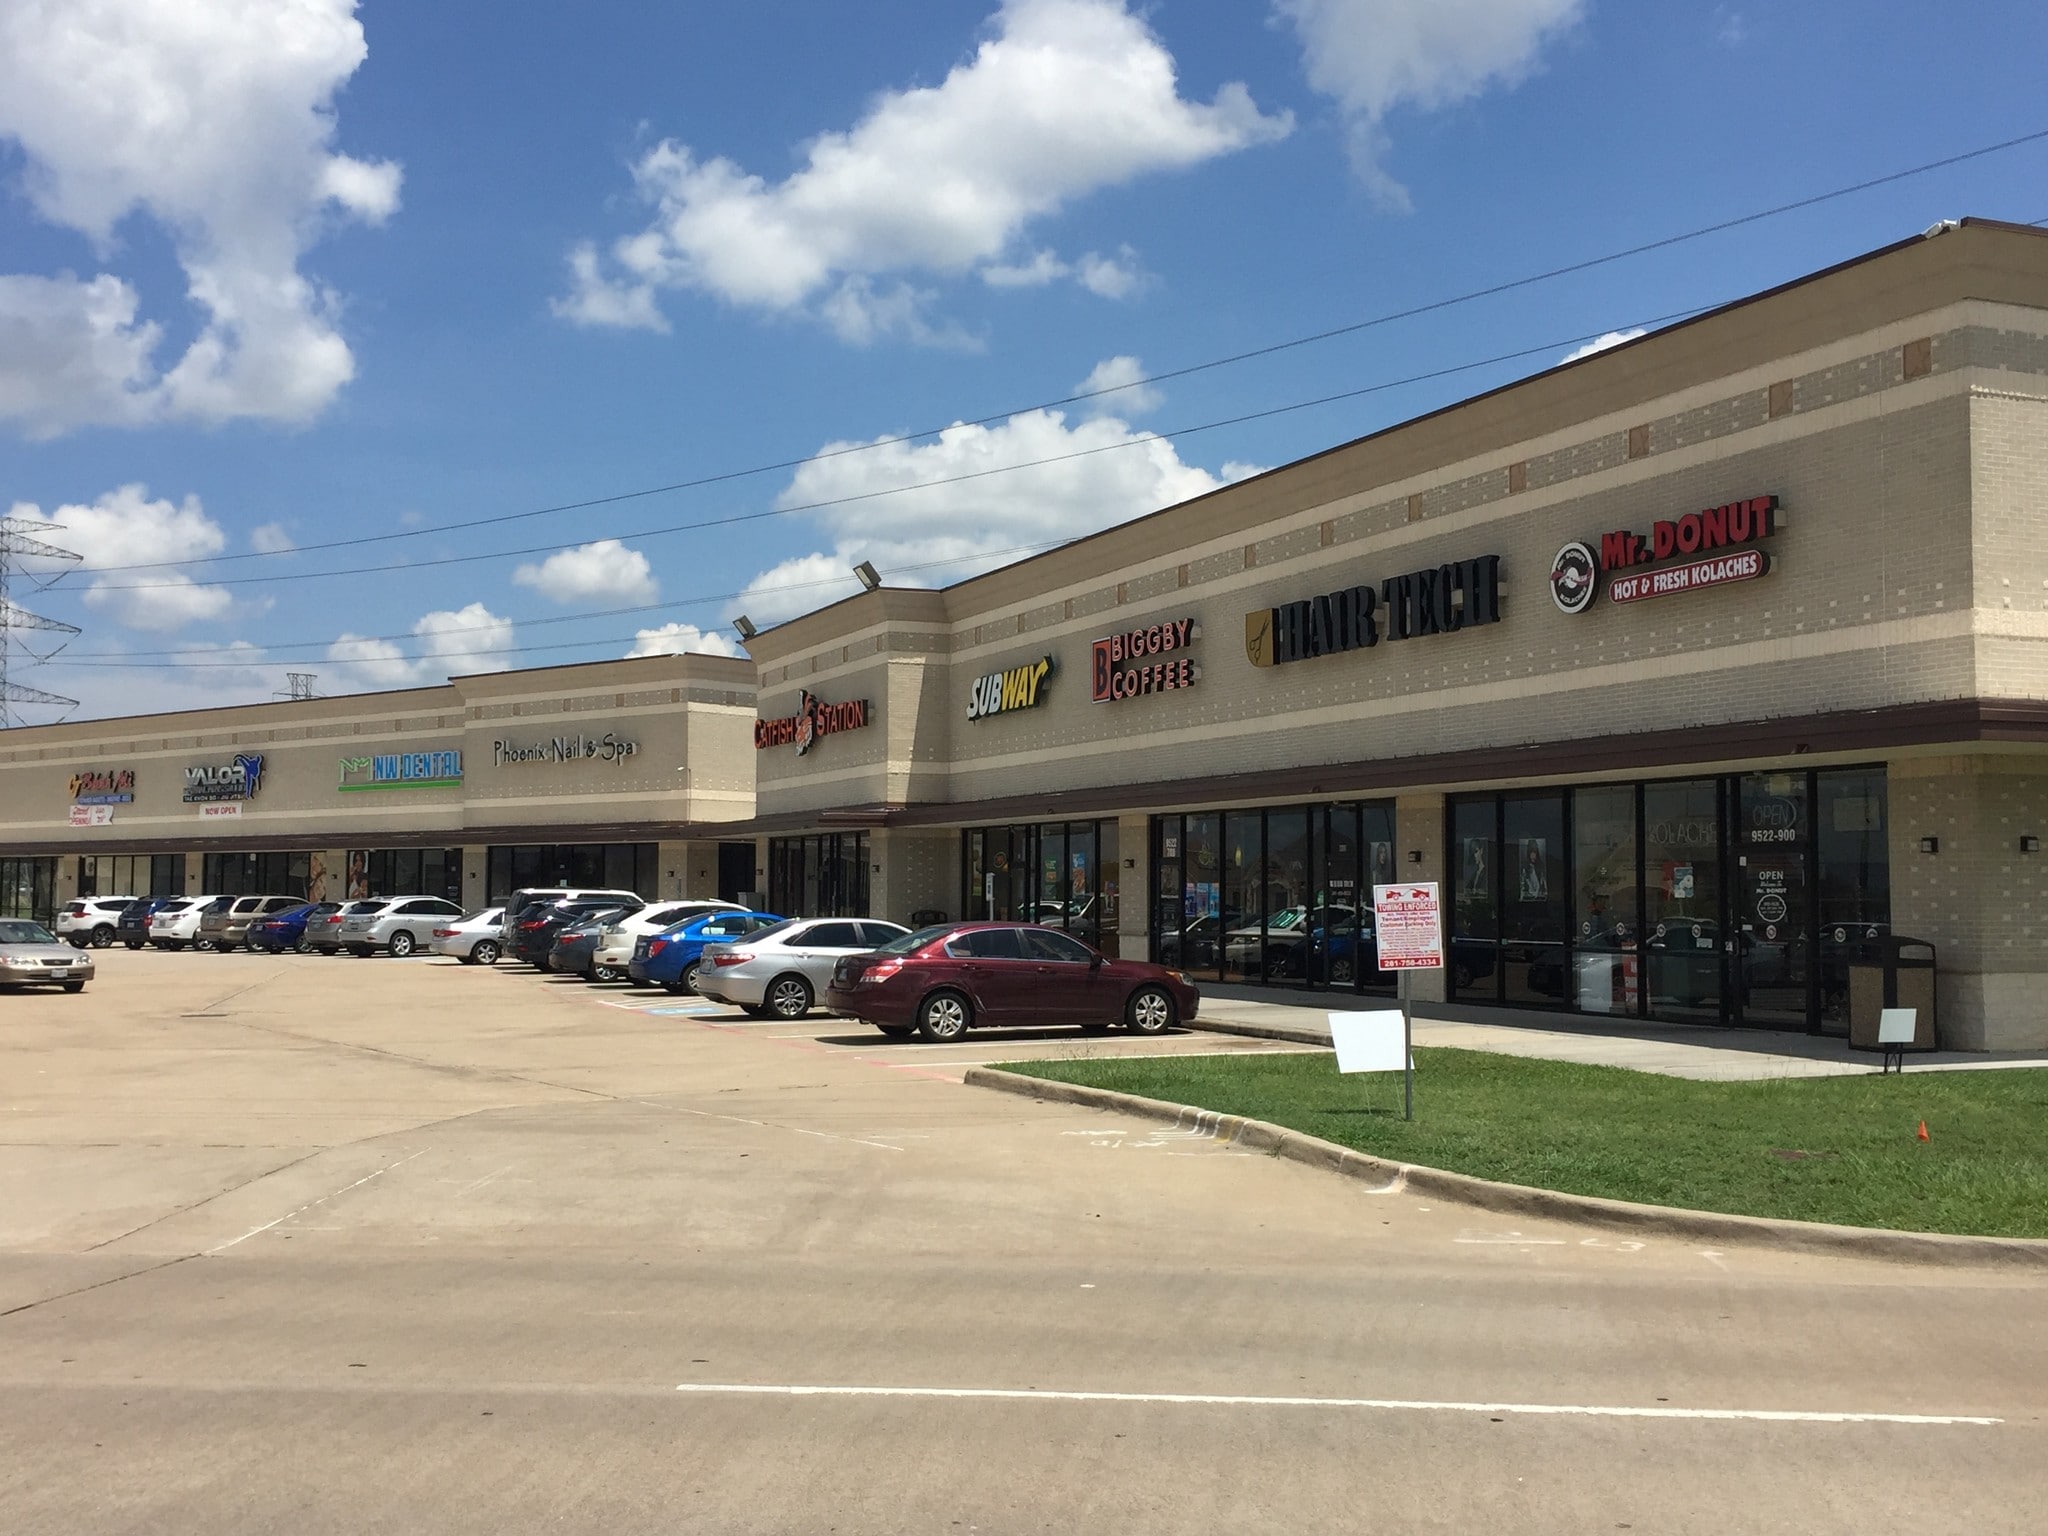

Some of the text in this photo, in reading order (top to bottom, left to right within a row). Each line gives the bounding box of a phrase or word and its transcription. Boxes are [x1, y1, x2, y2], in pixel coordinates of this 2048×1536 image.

[1602, 496, 1771, 570] Mr. DONUT
[1614, 553, 1757, 600] HOT & FRESH KOLACHES
[1280, 555, 1500, 663] HAIR TECH
[1112, 618, 1190, 661] BIGGBY
[966, 659, 1050, 718] SUBWAY
[1112, 659, 1191, 700] COFFEE
[754, 699, 866, 749] CATFISH STATION
[375, 751, 462, 780] NW DENTAL
[494, 733, 635, 767] Phoenix Nail & Spa
[185, 766, 247, 785] VALOR
[205, 806, 237, 815] NOW OPEN
[1751, 829, 1796, 842] 9522-900
[1759, 871, 1784, 880] OPEN
[1378, 902, 1437, 911] TOWING ENFORCED
